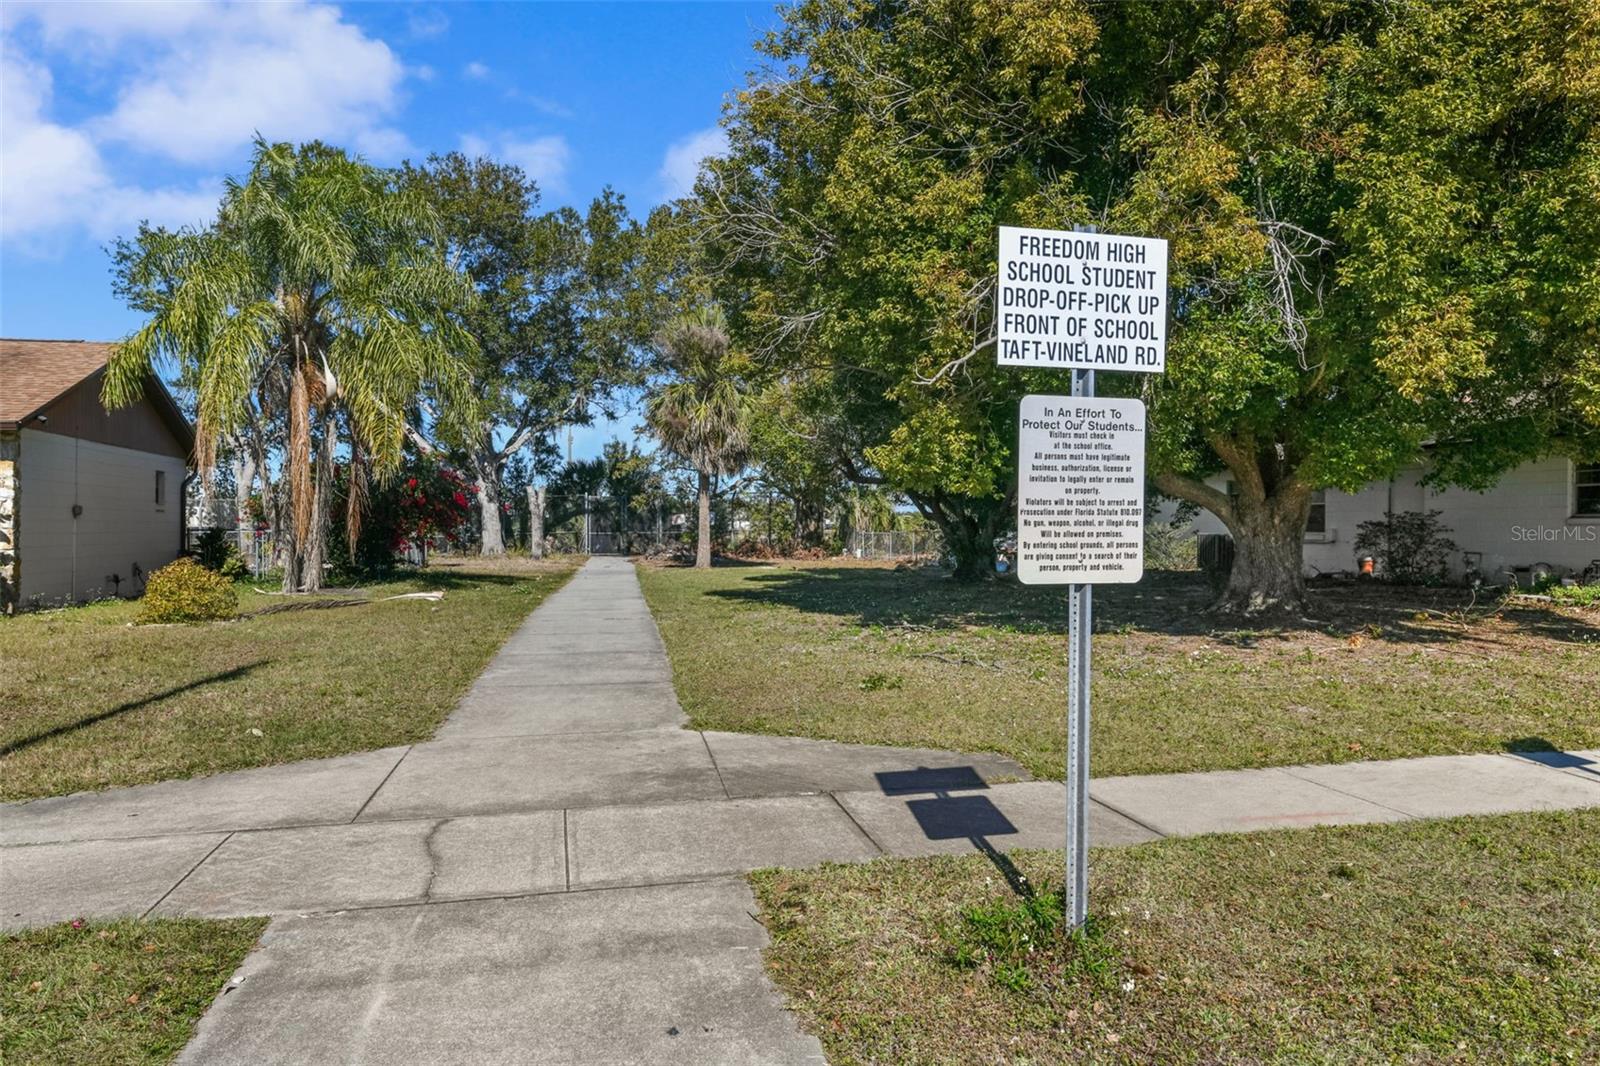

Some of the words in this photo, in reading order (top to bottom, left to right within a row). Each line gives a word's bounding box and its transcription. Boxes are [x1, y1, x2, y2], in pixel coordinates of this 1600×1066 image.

[1020, 235, 1099, 260] FREEDOM
[1107, 243, 1145, 264] HIGH
[1008, 261, 1074, 284] SCHOOL
[1082, 266, 1156, 290] STUDENT
[1003, 287, 1131, 314] DROP-OFF-PICK
[1138, 296, 1159, 315] UP
[1004, 314, 1060, 335] FRONT
[1067, 317, 1087, 336] OF
[1094, 319, 1158, 340] SCHOOL
[1001, 339, 1127, 364] TAFT-VINELAND
[1135, 346, 1160, 366] RD.
[1022, 419, 1060, 429] Protect
[1065, 420, 1082, 430] Our
[1088, 421, 1142, 432] Students...
[1044, 408, 1053, 417] In
[1058, 408, 1071, 417] An
[1076, 408, 1105, 418] Effort
[1110, 409, 1122, 418] To
